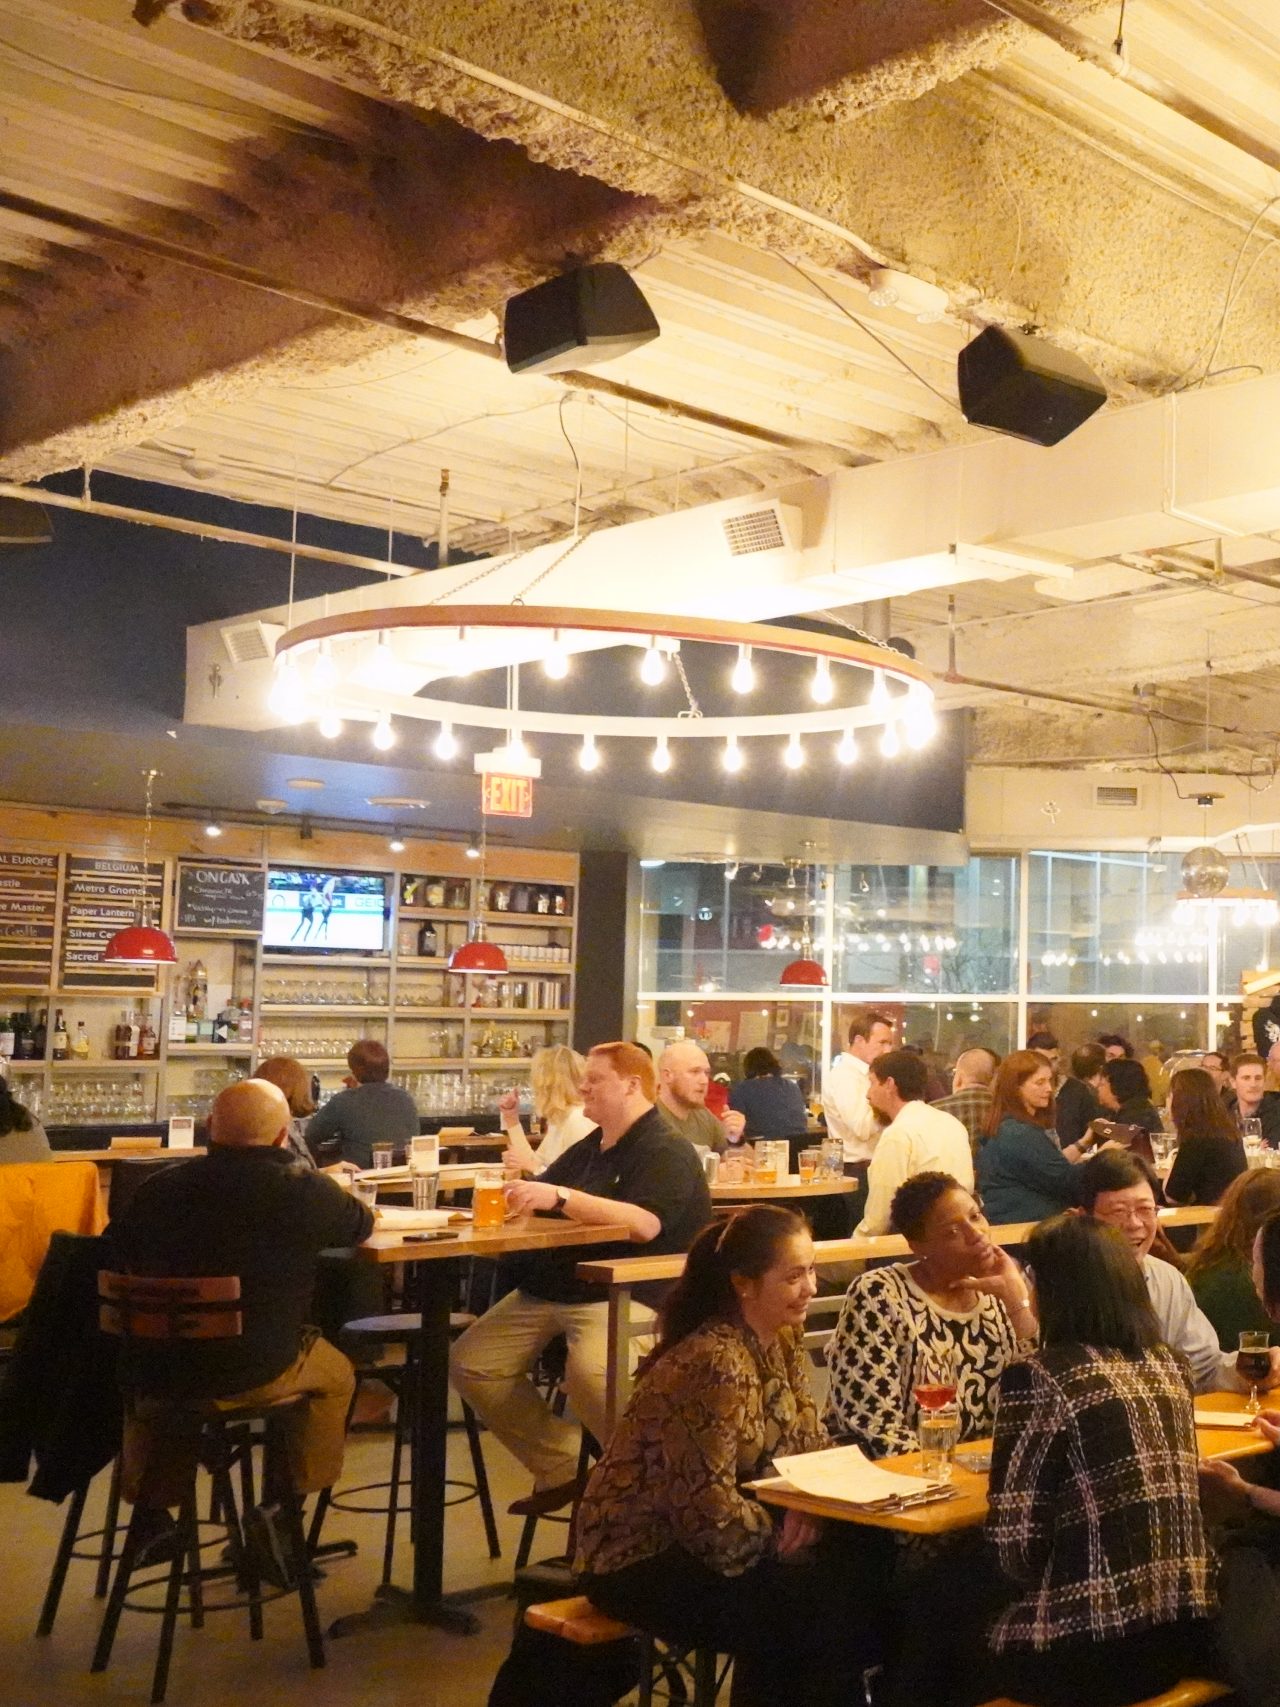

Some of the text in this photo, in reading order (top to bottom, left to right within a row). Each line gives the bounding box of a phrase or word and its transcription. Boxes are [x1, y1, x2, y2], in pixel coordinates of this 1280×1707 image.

[490, 776, 528, 812] EXIT
[12, 855, 54, 867] EUROPE
[94, 861, 139, 873] BELGIUM
[220, 871, 250, 885] CASK
[74, 884, 105, 893] Metro
[11, 903, 46, 912] Master
[70, 906, 134, 918] Paper Lantern
[69, 929, 96, 938] Silver
[65, 951, 99, 961] Sacred
